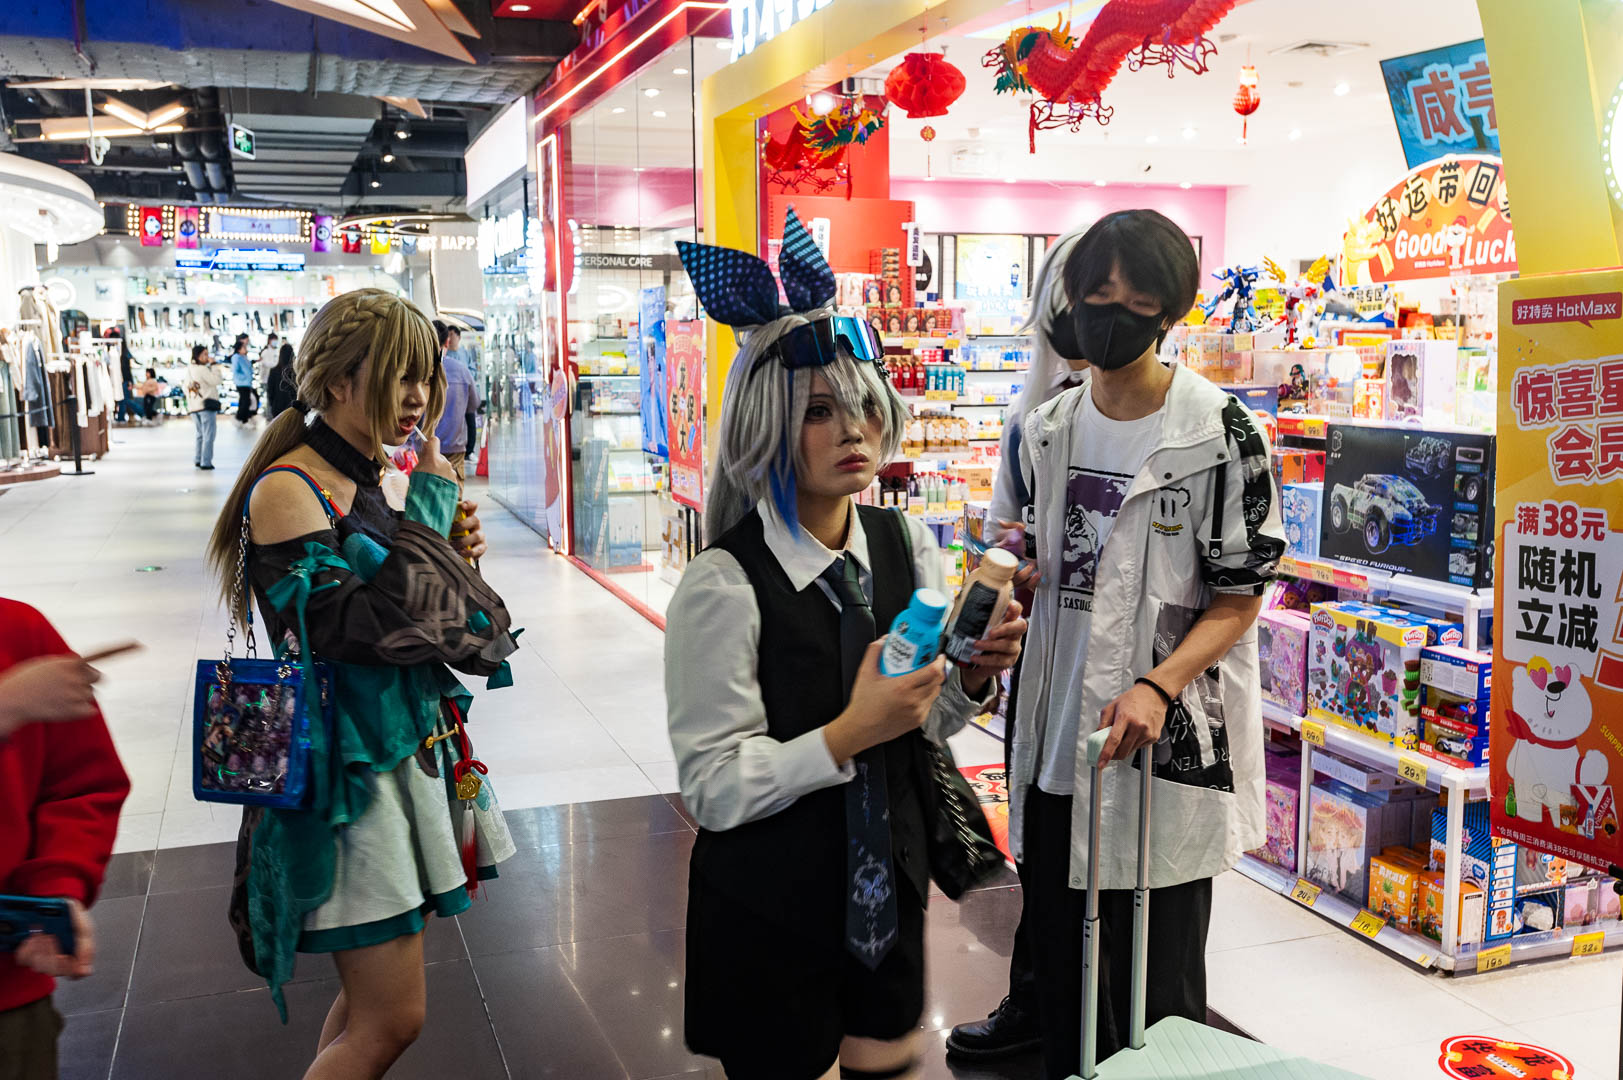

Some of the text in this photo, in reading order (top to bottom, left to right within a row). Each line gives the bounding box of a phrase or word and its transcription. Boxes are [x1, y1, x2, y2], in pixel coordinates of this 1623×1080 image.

[441, 236, 479, 251] HAPP
[580, 256, 653, 268] PERSONAL CARE
[1395, 226, 1517, 267] Good Luck
[1516, 300, 1617, 321] 好特卖 HotMaxx
[1516, 363, 1623, 423] 惊喜星
[1553, 424, 1623, 478] 会员
[1517, 503, 1607, 541] 满38元
[1339, 555, 1369, 566] SPEED
[1518, 545, 1603, 599] 随机
[1515, 596, 1599, 654] 立减
[1171, 746, 1229, 774] ROTEN
